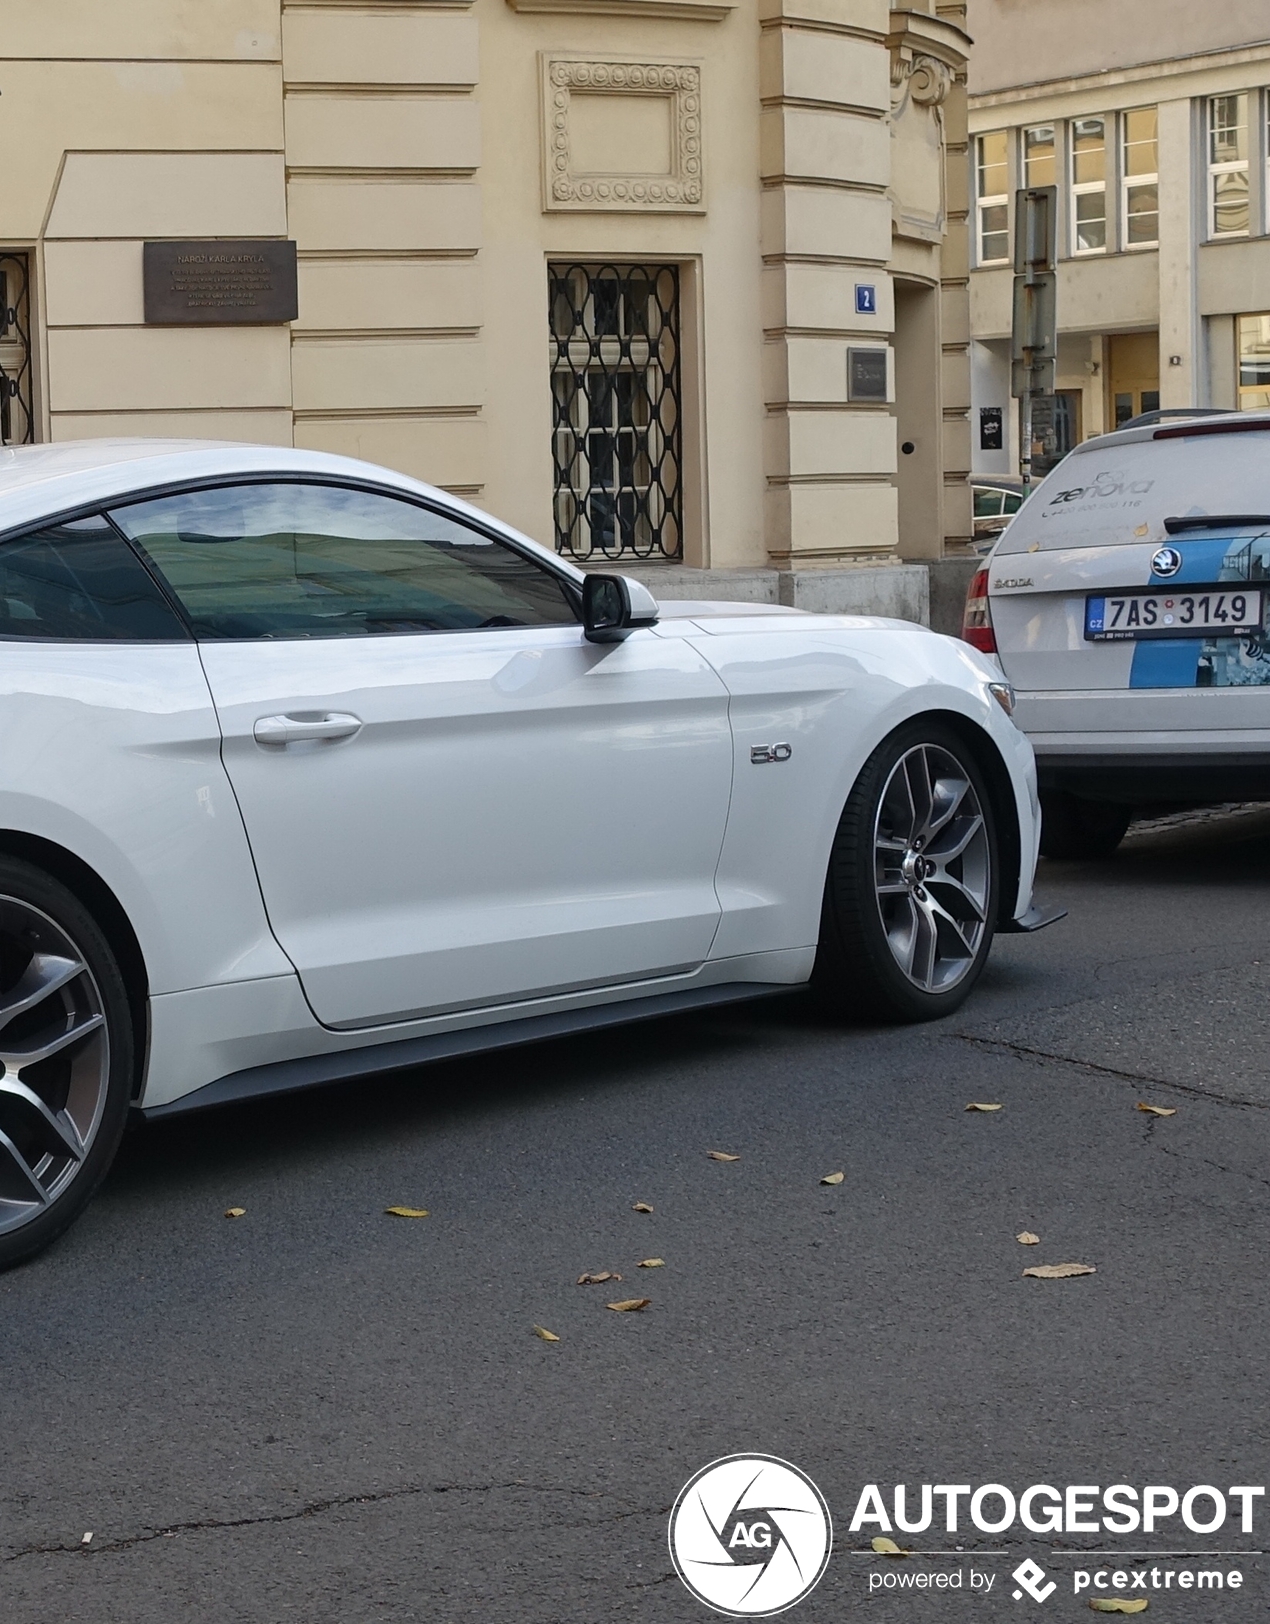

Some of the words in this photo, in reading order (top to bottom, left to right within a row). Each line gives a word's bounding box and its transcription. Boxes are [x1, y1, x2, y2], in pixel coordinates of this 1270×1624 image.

[209, 255, 237, 263] KARLA
[238, 255, 264, 263] KRYLA
[863, 290, 870, 307] 2
[1049, 479, 1155, 505] zenova
[1110, 599, 1158, 627] 7AS
[1179, 595, 1247, 624] 3149
[1090, 619, 1103, 629] CZ
[750, 742, 792, 765] 5.0
